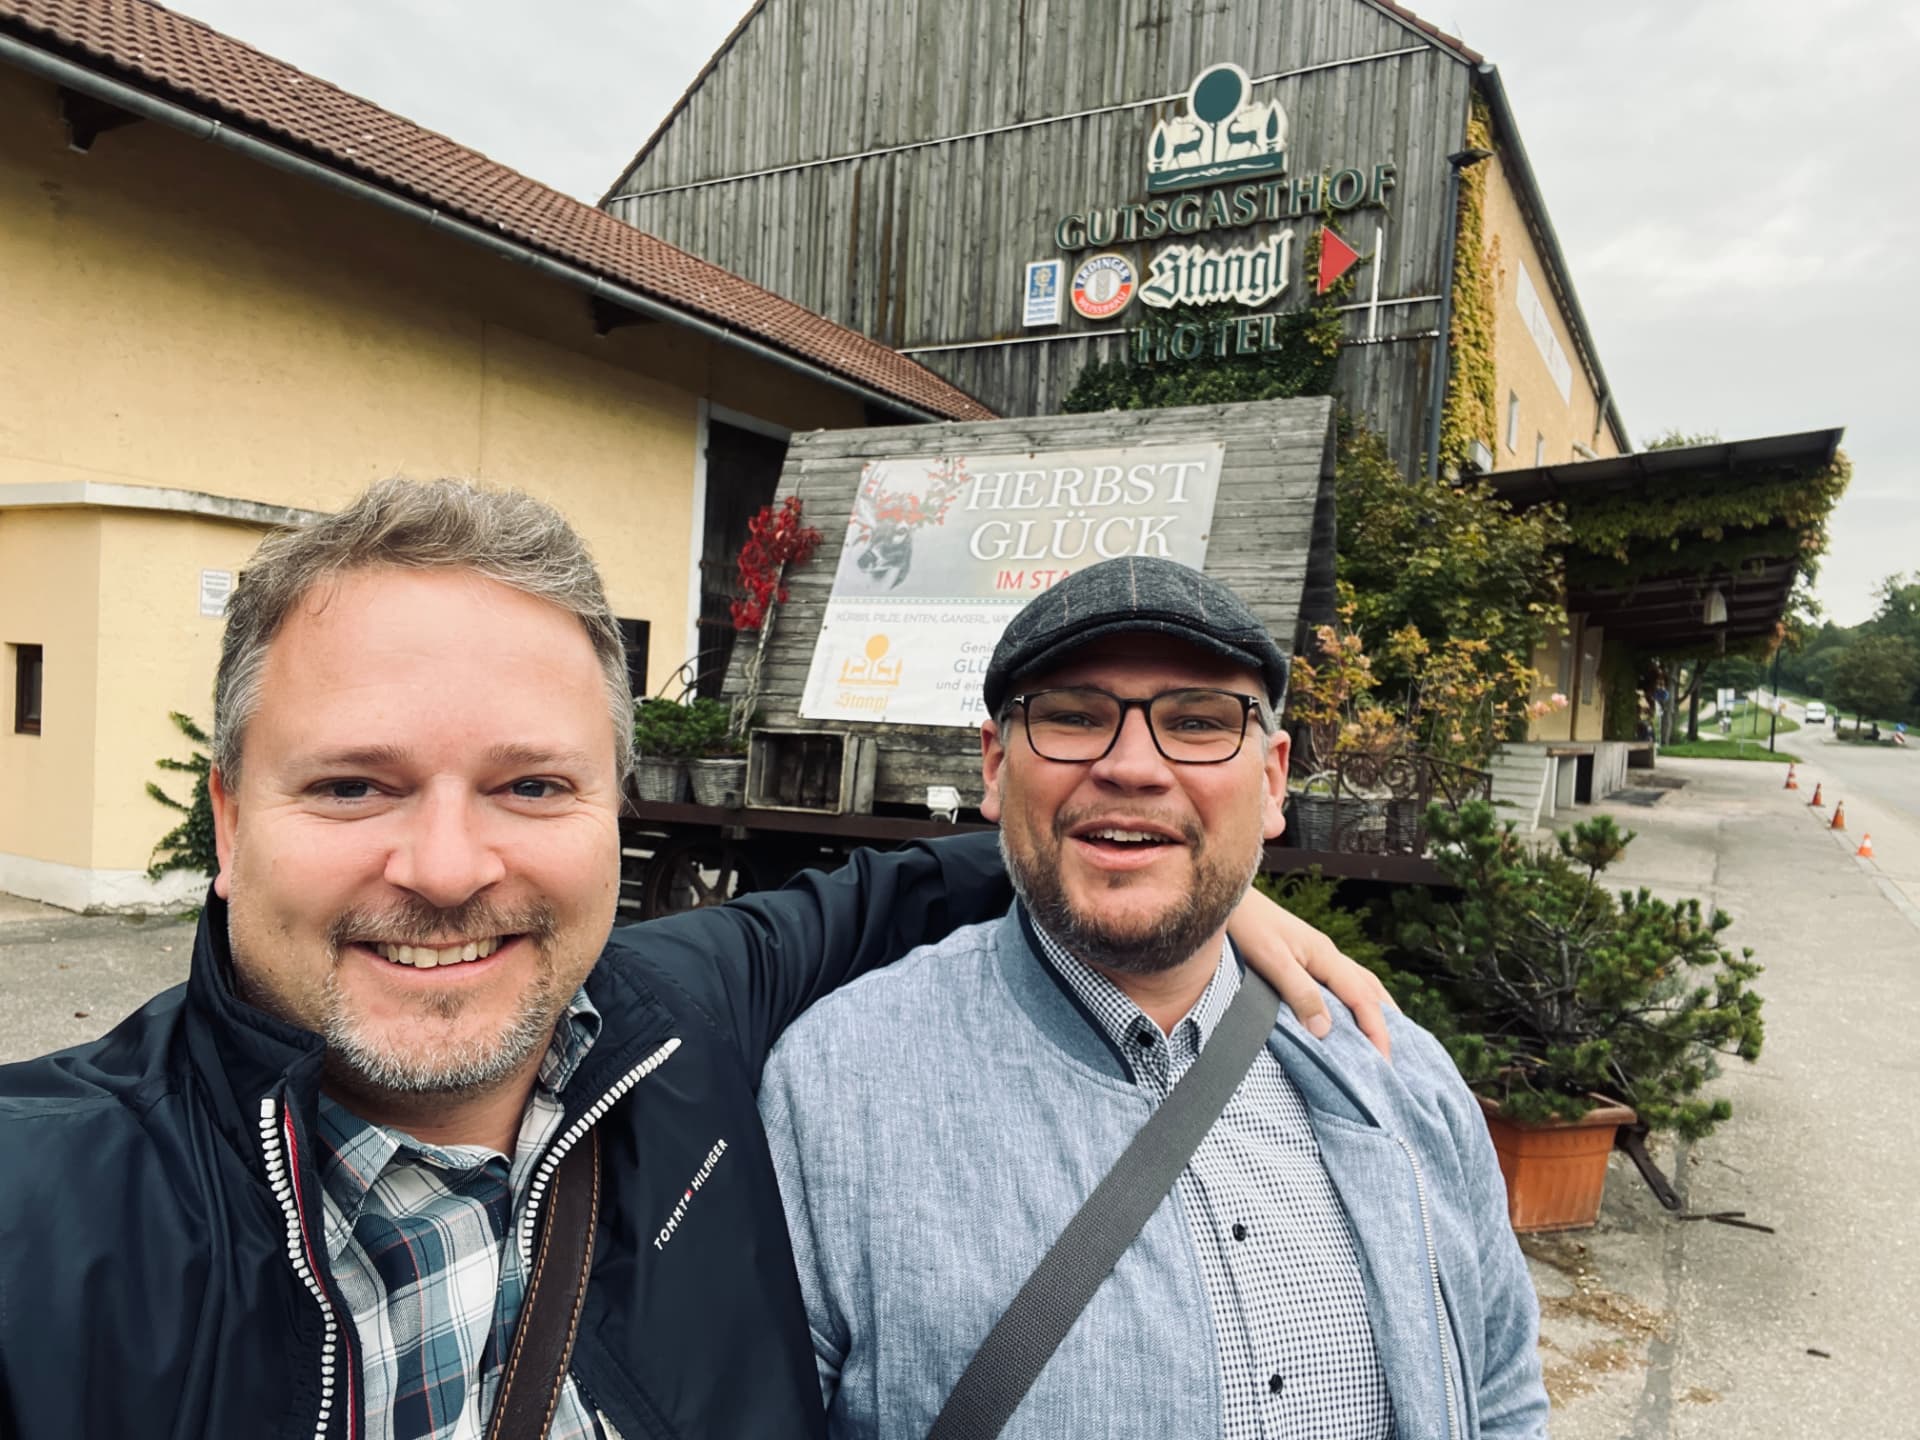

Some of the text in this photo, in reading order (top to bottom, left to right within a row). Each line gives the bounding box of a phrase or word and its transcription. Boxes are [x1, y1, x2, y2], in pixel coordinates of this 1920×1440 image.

[1055, 162, 1397, 251] GUTSGASTHOF
[1076, 257, 1131, 287] ERDINGER
[1140, 230, 1293, 308] Stangl
[1138, 315, 1283, 363] HOTEL
[964, 461, 1206, 511] HERBST
[969, 510, 1180, 560] GLÜCK
[996, 569, 1025, 590] IM
[936, 679, 961, 690] und
[653, 1139, 728, 1250] TOMMY HILFIGER
